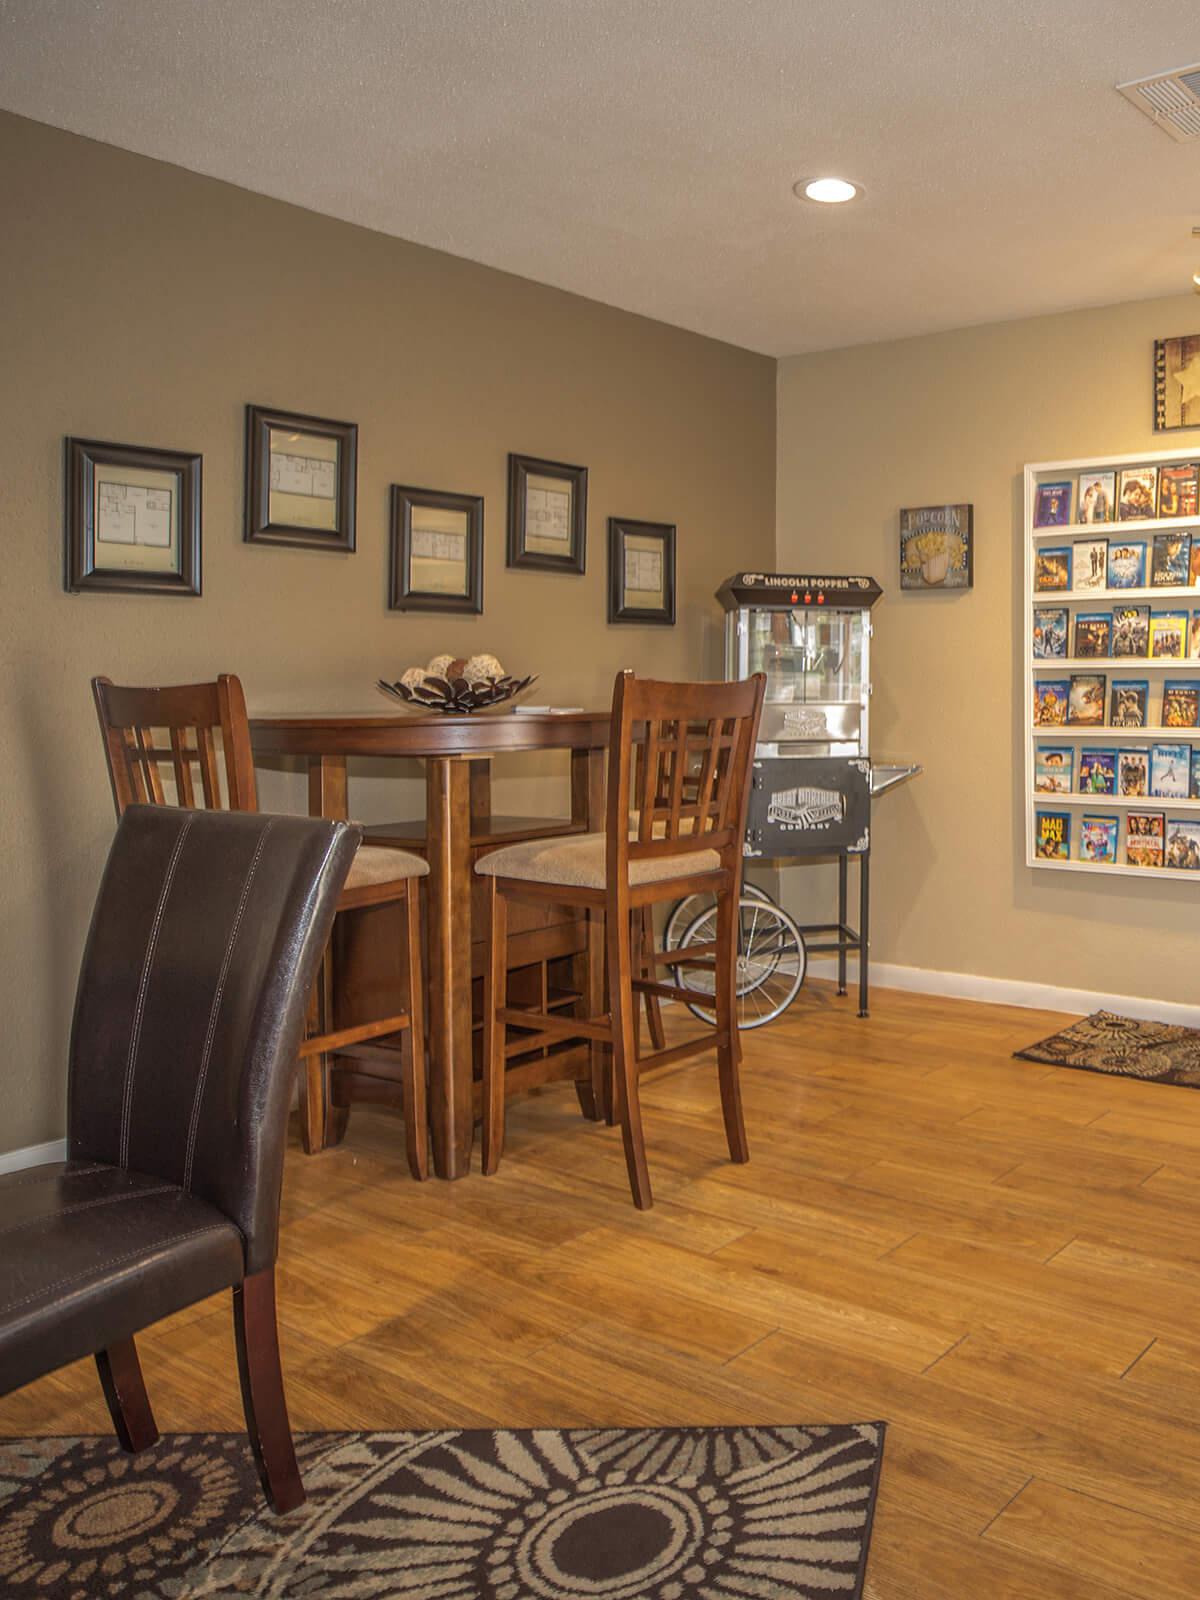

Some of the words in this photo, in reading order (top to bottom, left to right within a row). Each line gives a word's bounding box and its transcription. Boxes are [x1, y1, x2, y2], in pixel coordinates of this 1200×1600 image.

[908, 509, 960, 530] POPCORN
[764, 577, 808, 587] LINCOLN
[810, 578, 849, 588] POPPER
[1041, 817, 1063, 831] MAD
[1041, 829, 1063, 841] MAX
